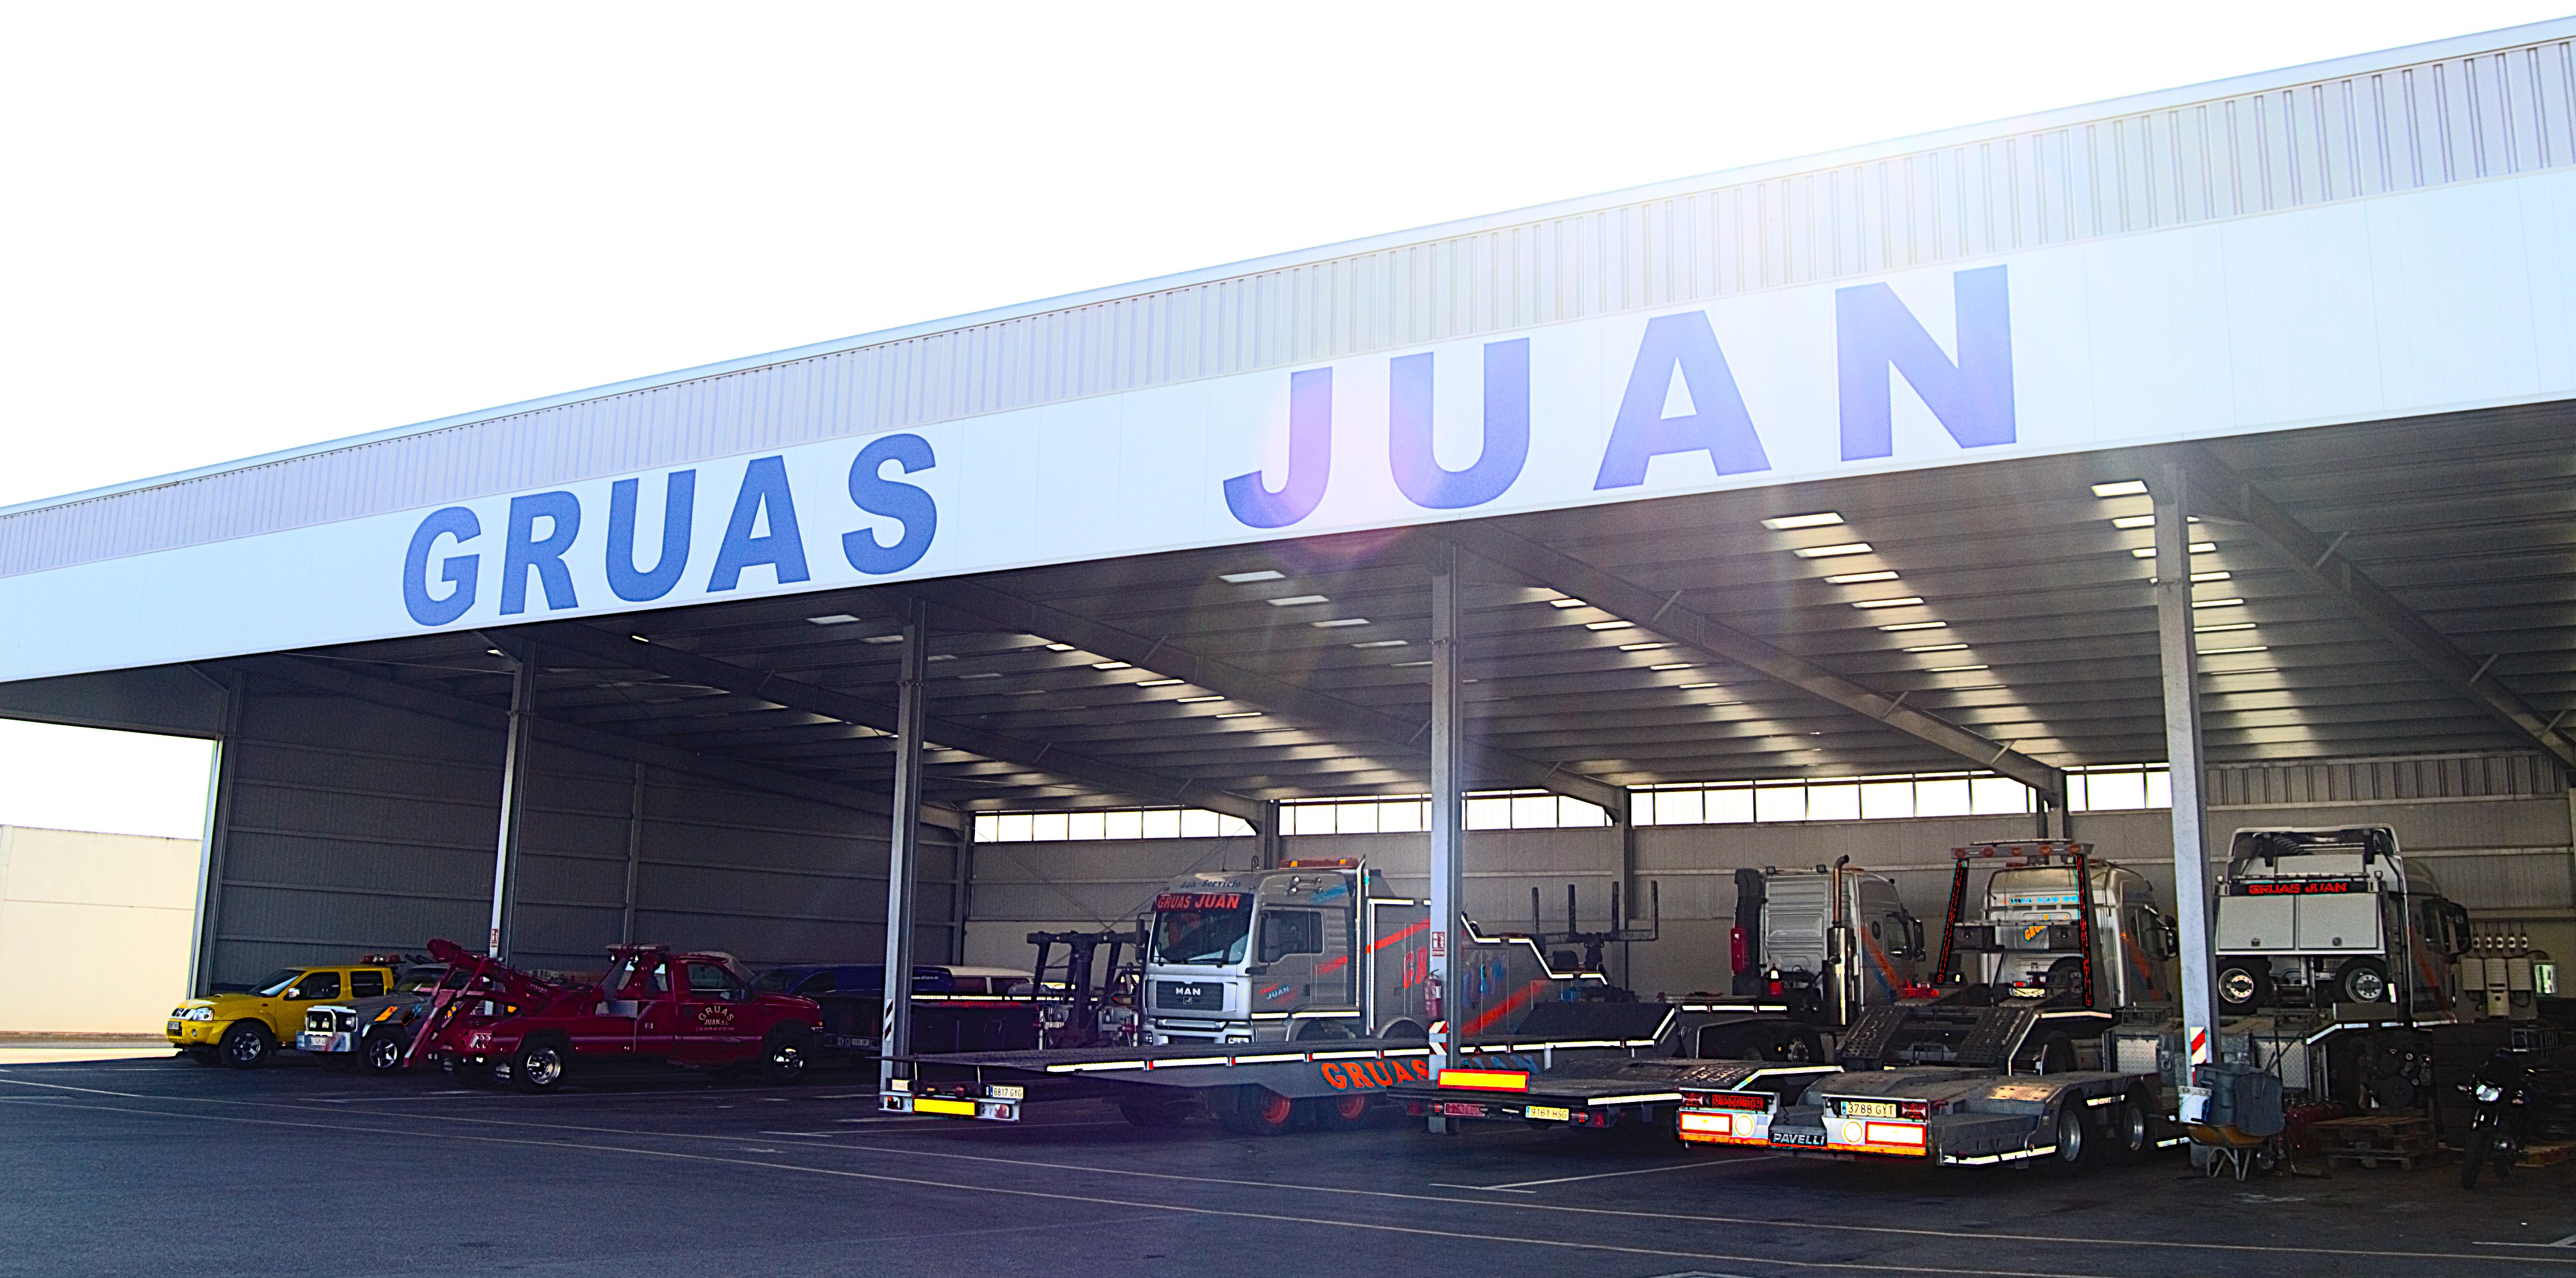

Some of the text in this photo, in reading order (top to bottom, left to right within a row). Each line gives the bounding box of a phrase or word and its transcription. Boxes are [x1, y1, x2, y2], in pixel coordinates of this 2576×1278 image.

[403, 264, 2016, 626] GRUAS JUAN
[2249, 882, 2347, 894] GRUAS JUAN
[1157, 894, 1239, 909] GRUAS JUAN
[1267, 986, 1289, 1000] JUAN
[699, 1005, 734, 1021] GRUAS
[1321, 1059, 1429, 1089] GRUAS
[994, 1088, 1008, 1096] 6817
[1531, 1108, 1567, 1119] 9161 HSG
[1848, 1104, 1893, 1115] 3788 GYT
[1773, 1133, 1825, 1146] PAVELLI
